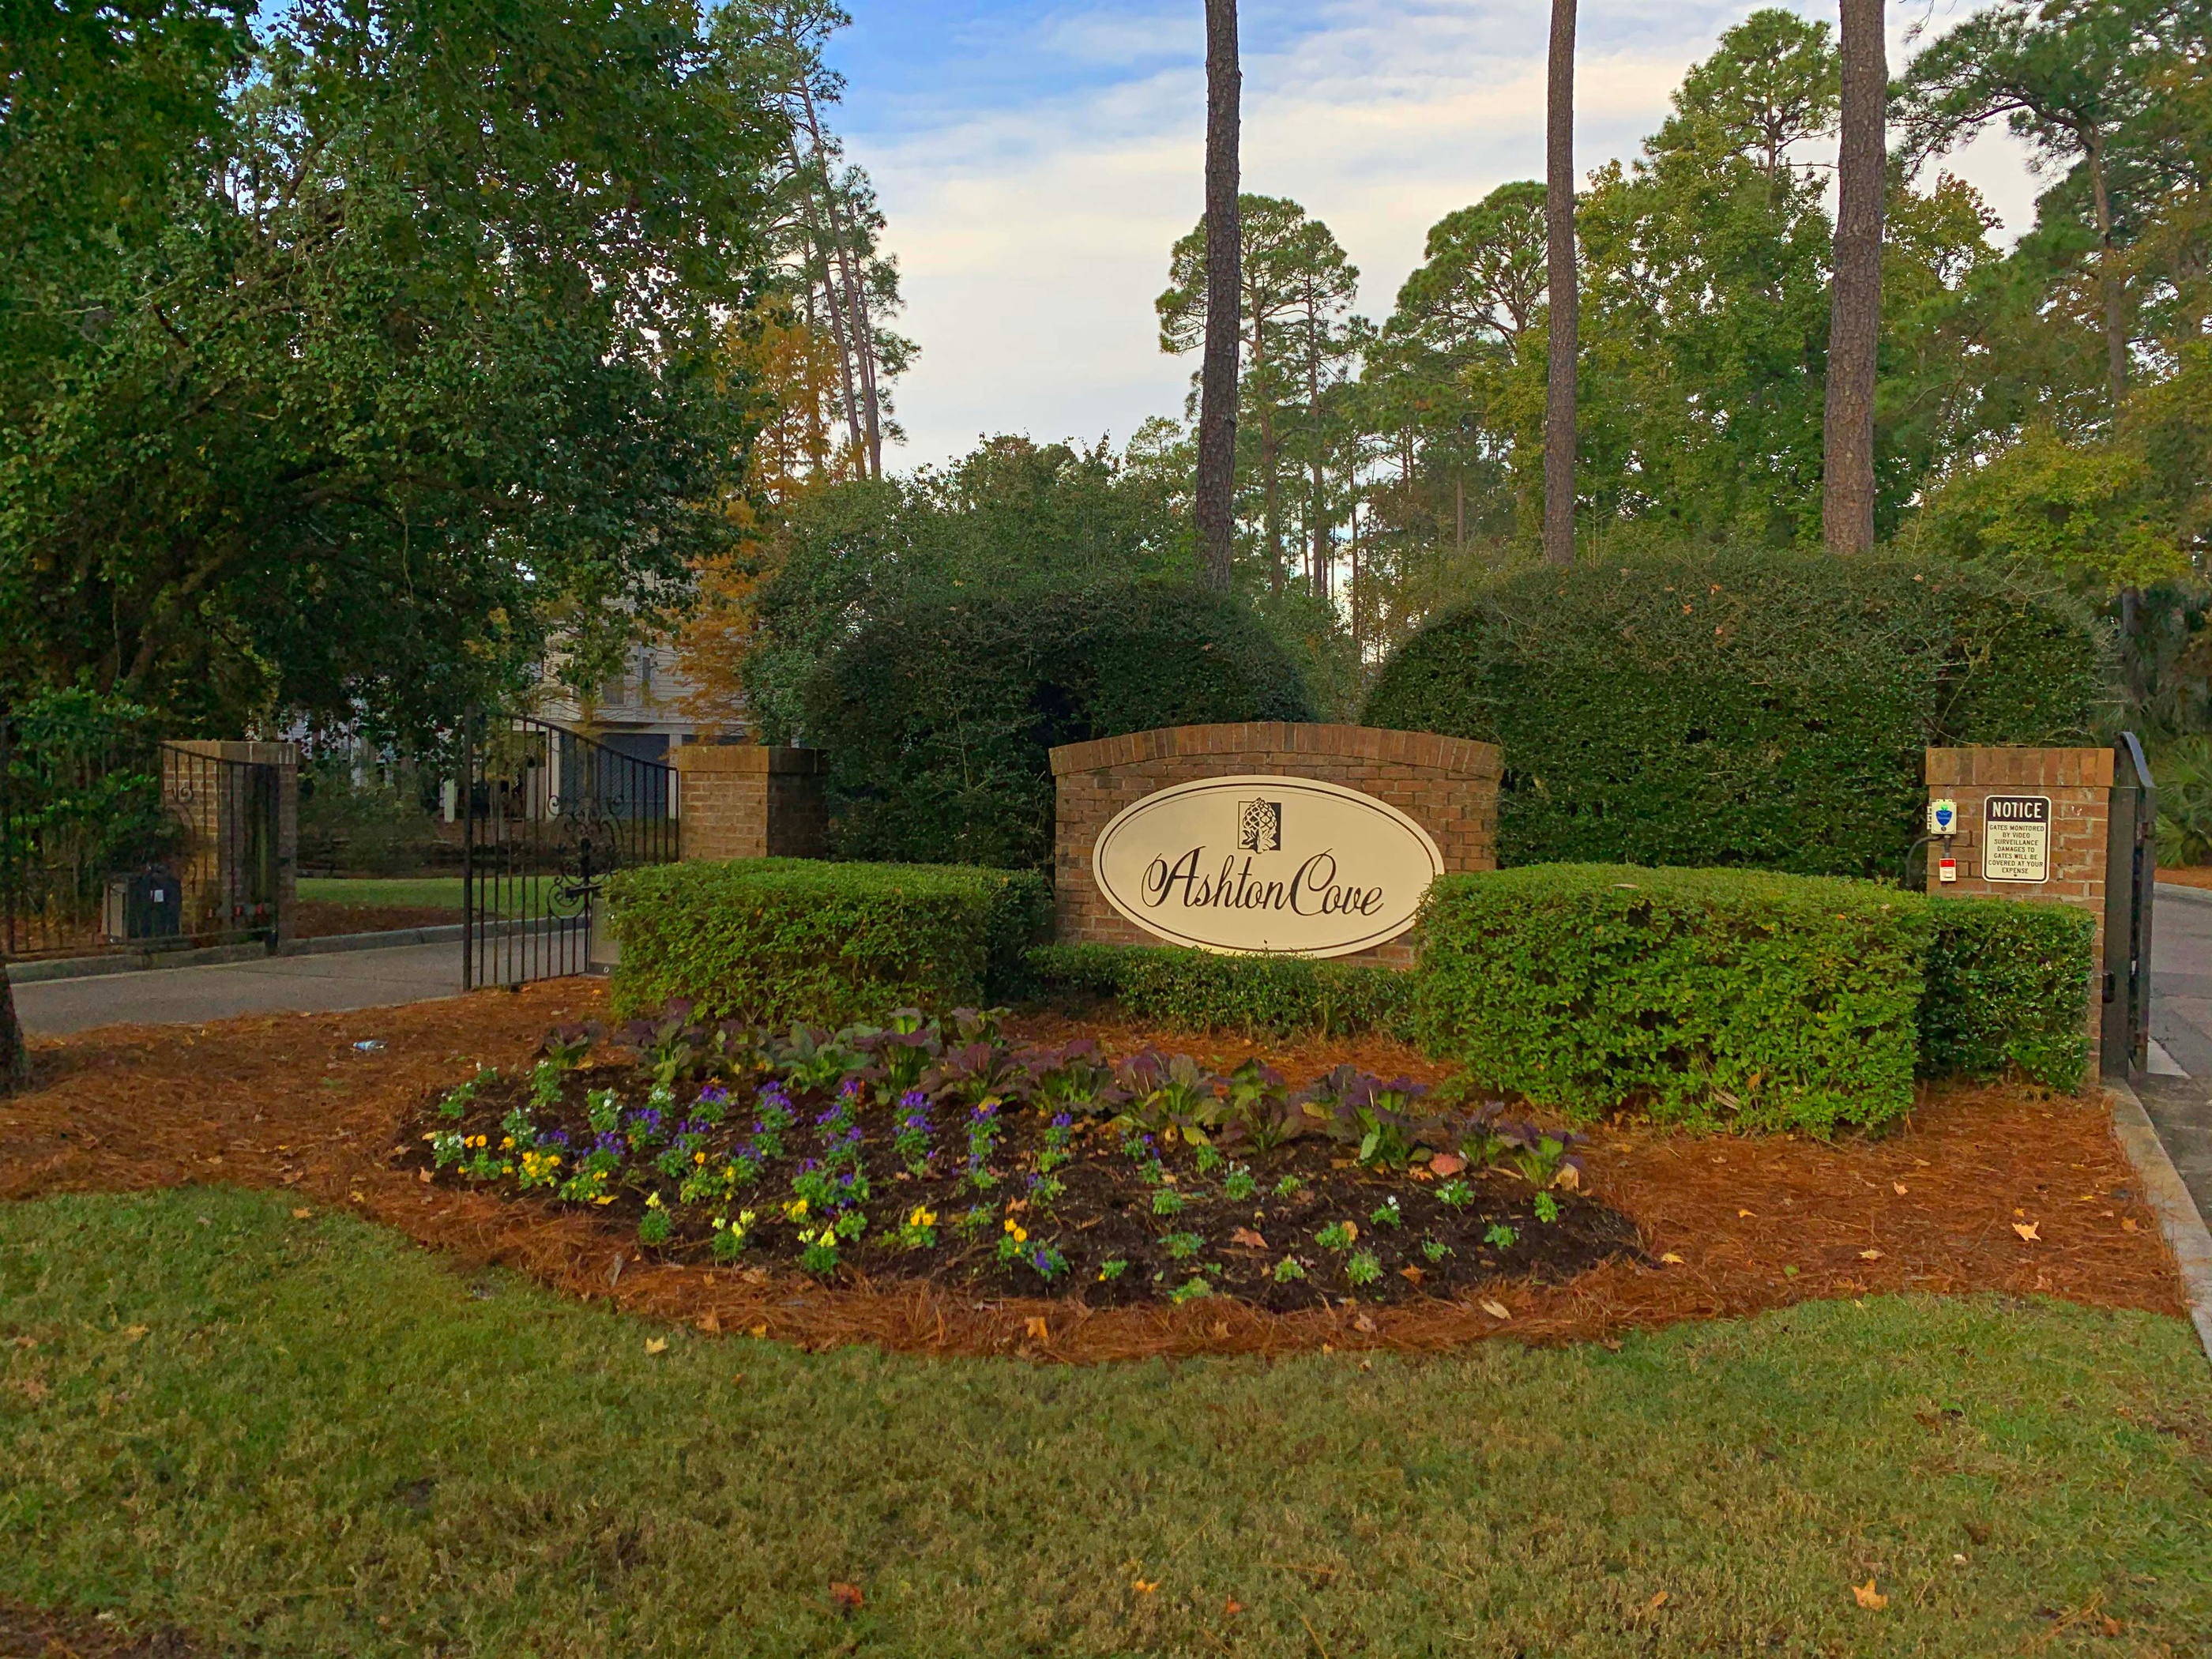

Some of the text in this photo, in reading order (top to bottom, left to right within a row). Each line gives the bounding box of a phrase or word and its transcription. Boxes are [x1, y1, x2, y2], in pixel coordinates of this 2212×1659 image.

[1992, 802, 2042, 818] NOTICE
[1141, 845, 1384, 916] Ashton Cove
